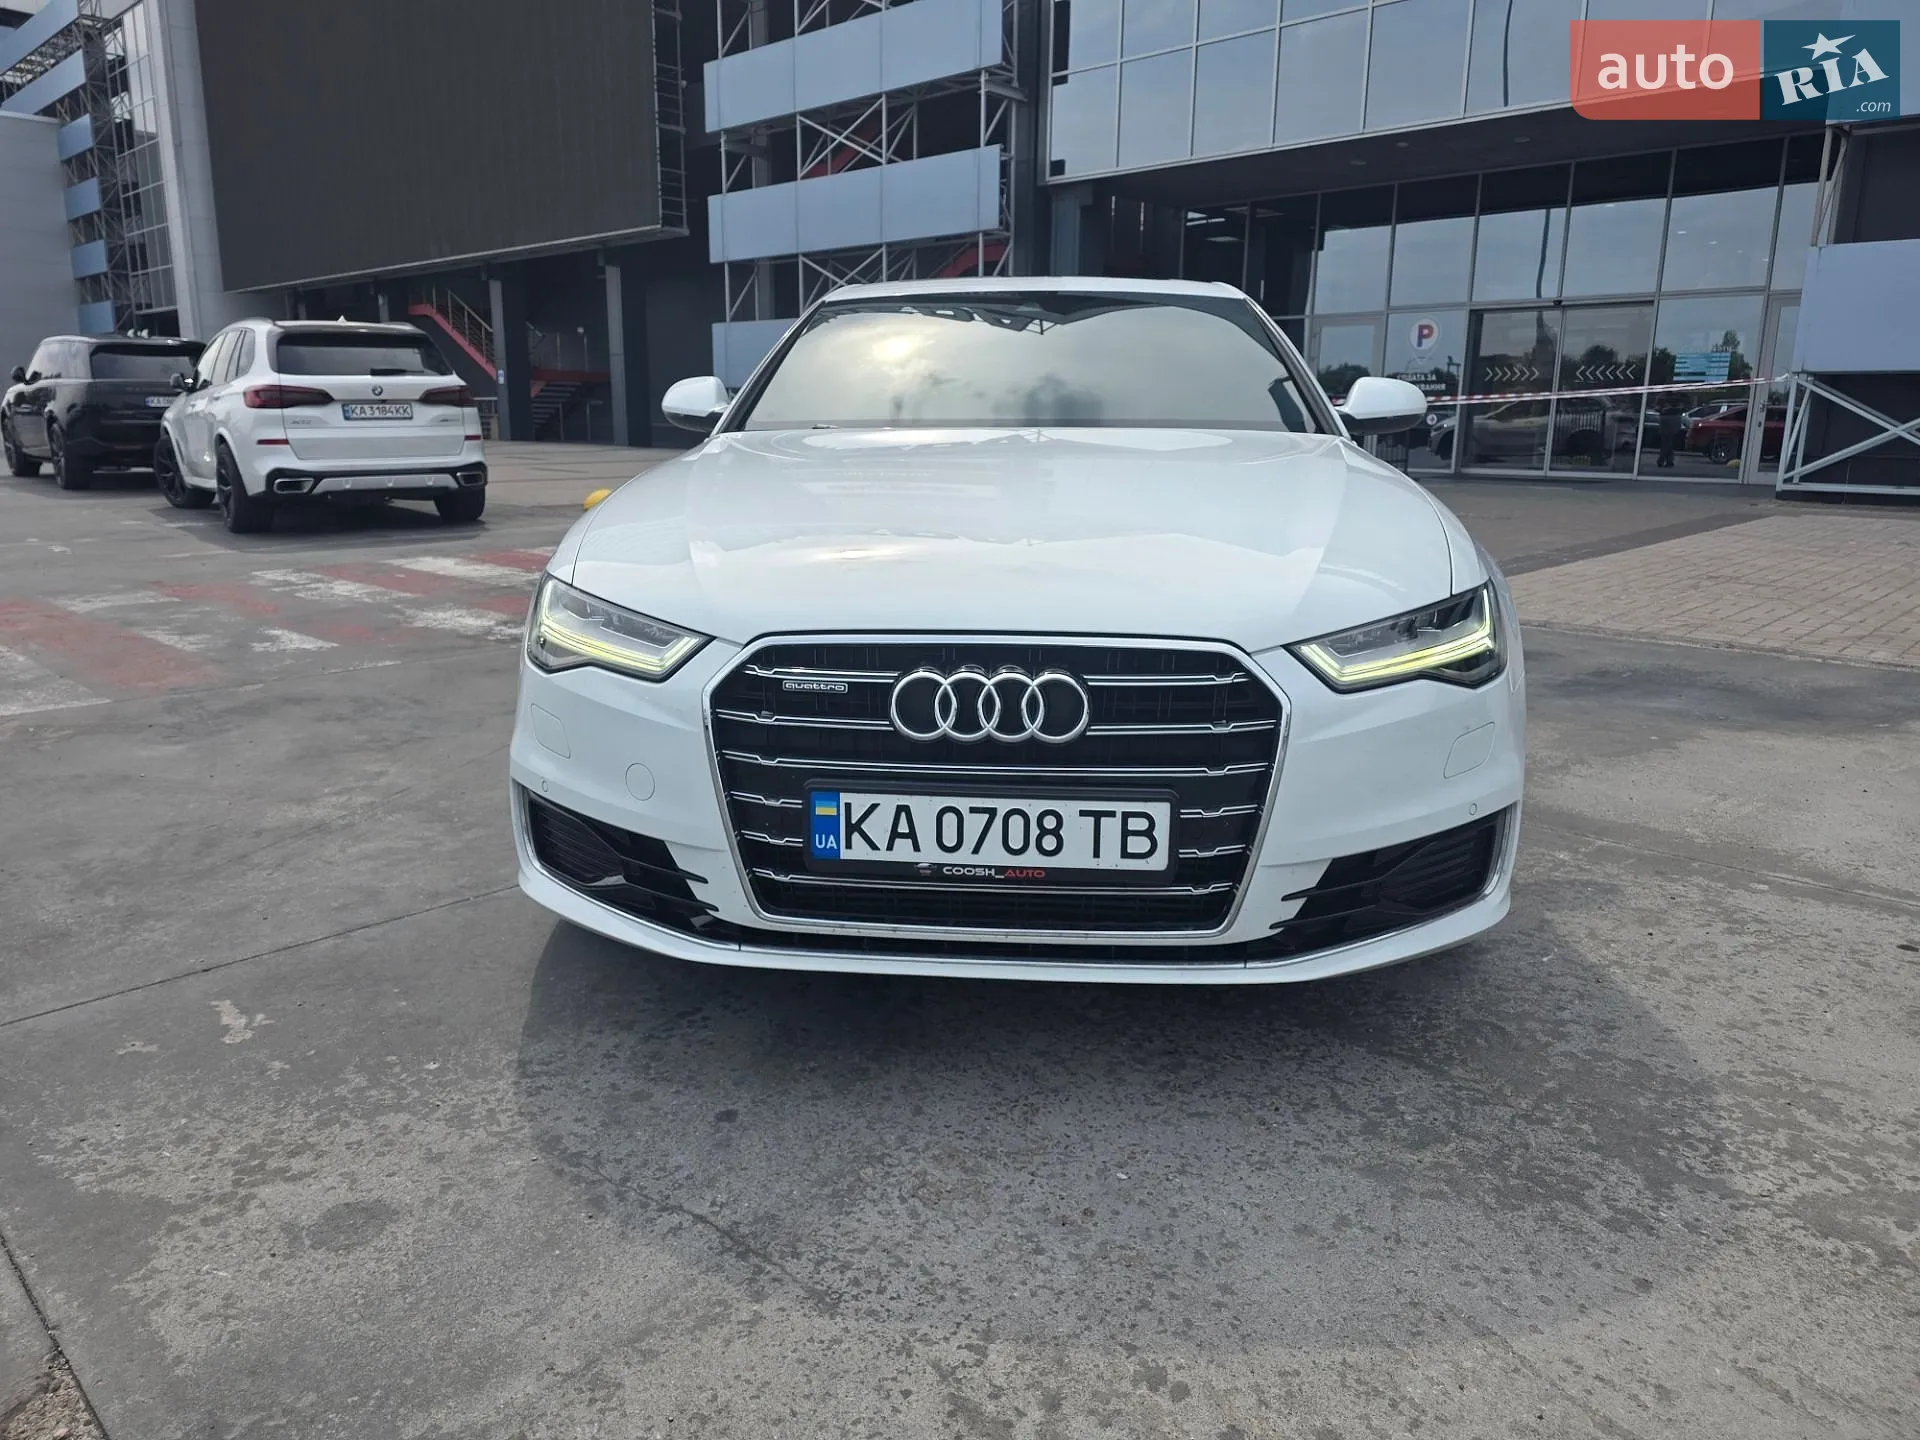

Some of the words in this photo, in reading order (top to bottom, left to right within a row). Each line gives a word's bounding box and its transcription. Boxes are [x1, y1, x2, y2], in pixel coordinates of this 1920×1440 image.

[1416, 324, 1434, 347] P
[785, 682, 844, 691] quattro
[844, 802, 921, 852] KA
[935, 806, 1064, 857] 0708
[1078, 810, 1159, 860] TB
[815, 834, 838, 849] UA
